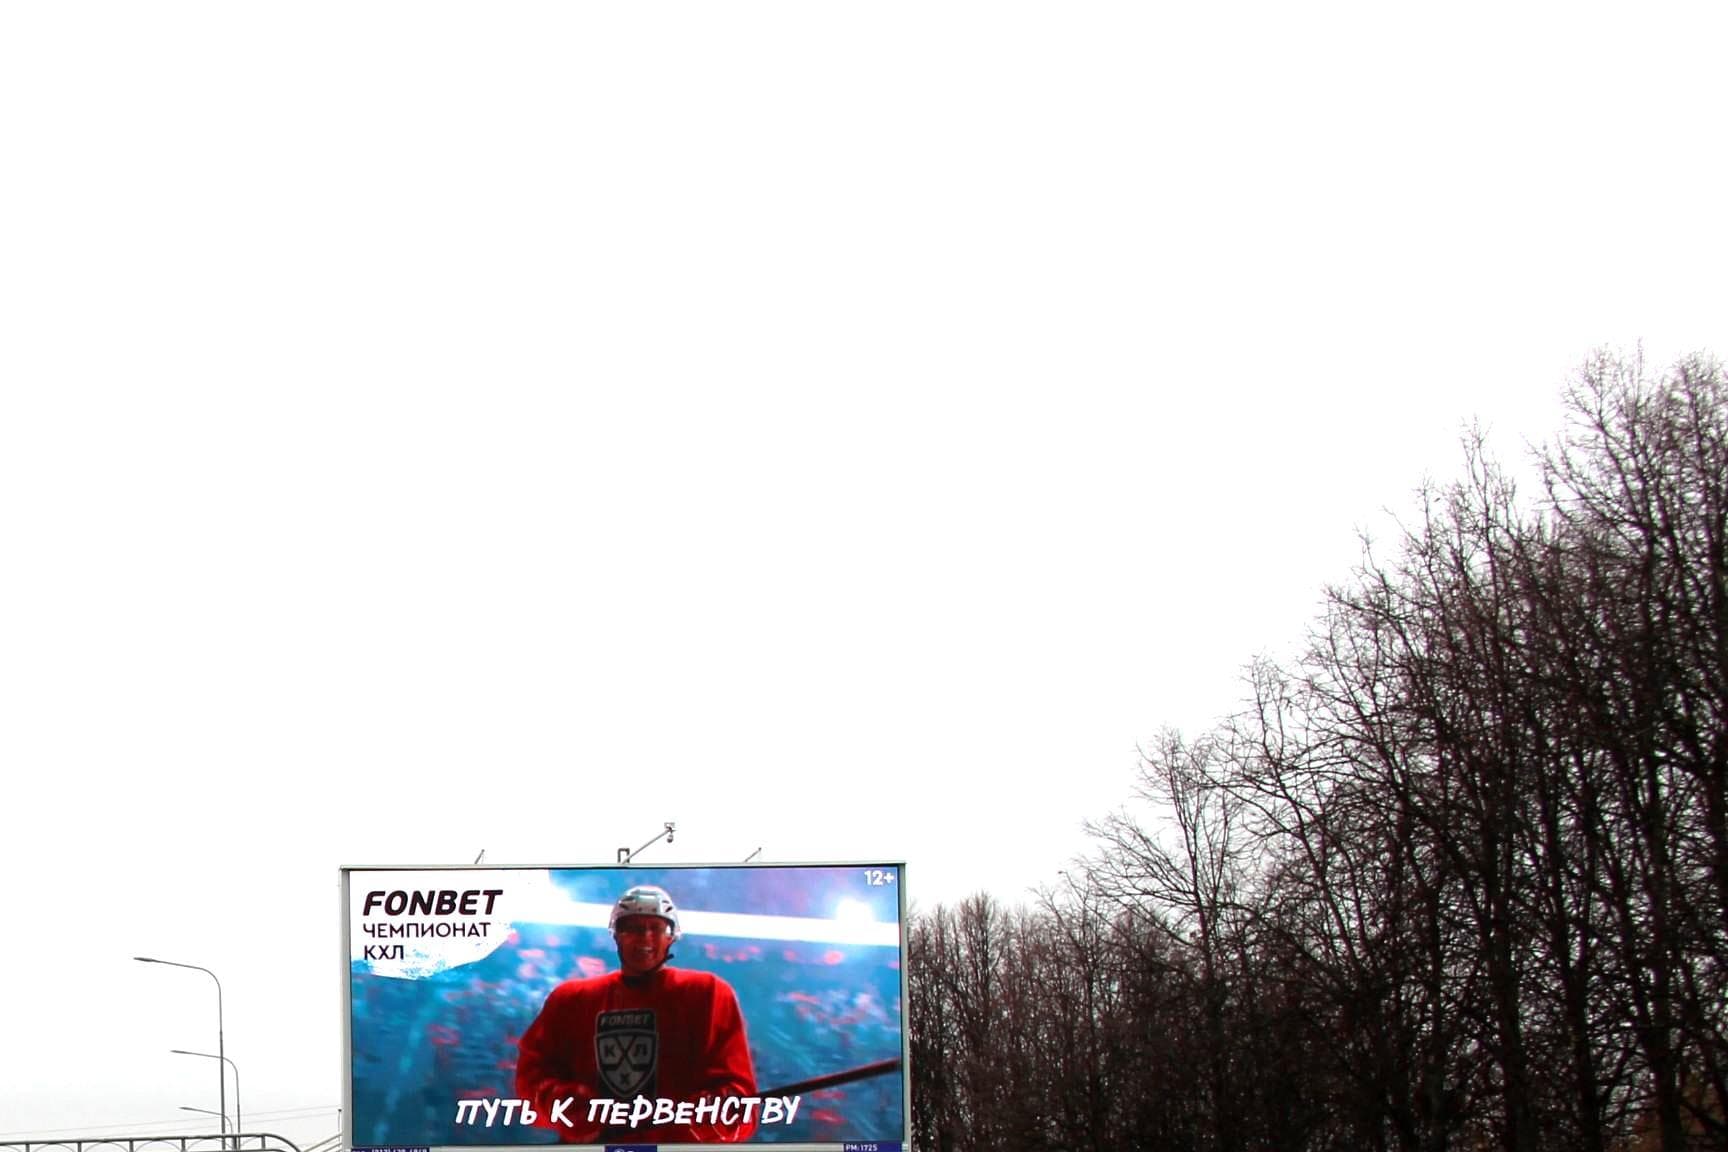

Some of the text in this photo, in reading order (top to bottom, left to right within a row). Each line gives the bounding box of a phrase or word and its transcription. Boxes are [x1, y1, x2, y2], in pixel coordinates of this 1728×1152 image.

[864, 870, 895, 886] 12+
[362, 889, 504, 917] FONBET
[363, 922, 492, 938] ЧЕМПИОНАТ
[363, 945, 405, 960] КХЛ
[455, 1095, 802, 1128] ПУТЬ К ПЕРВЕНСТВУ
